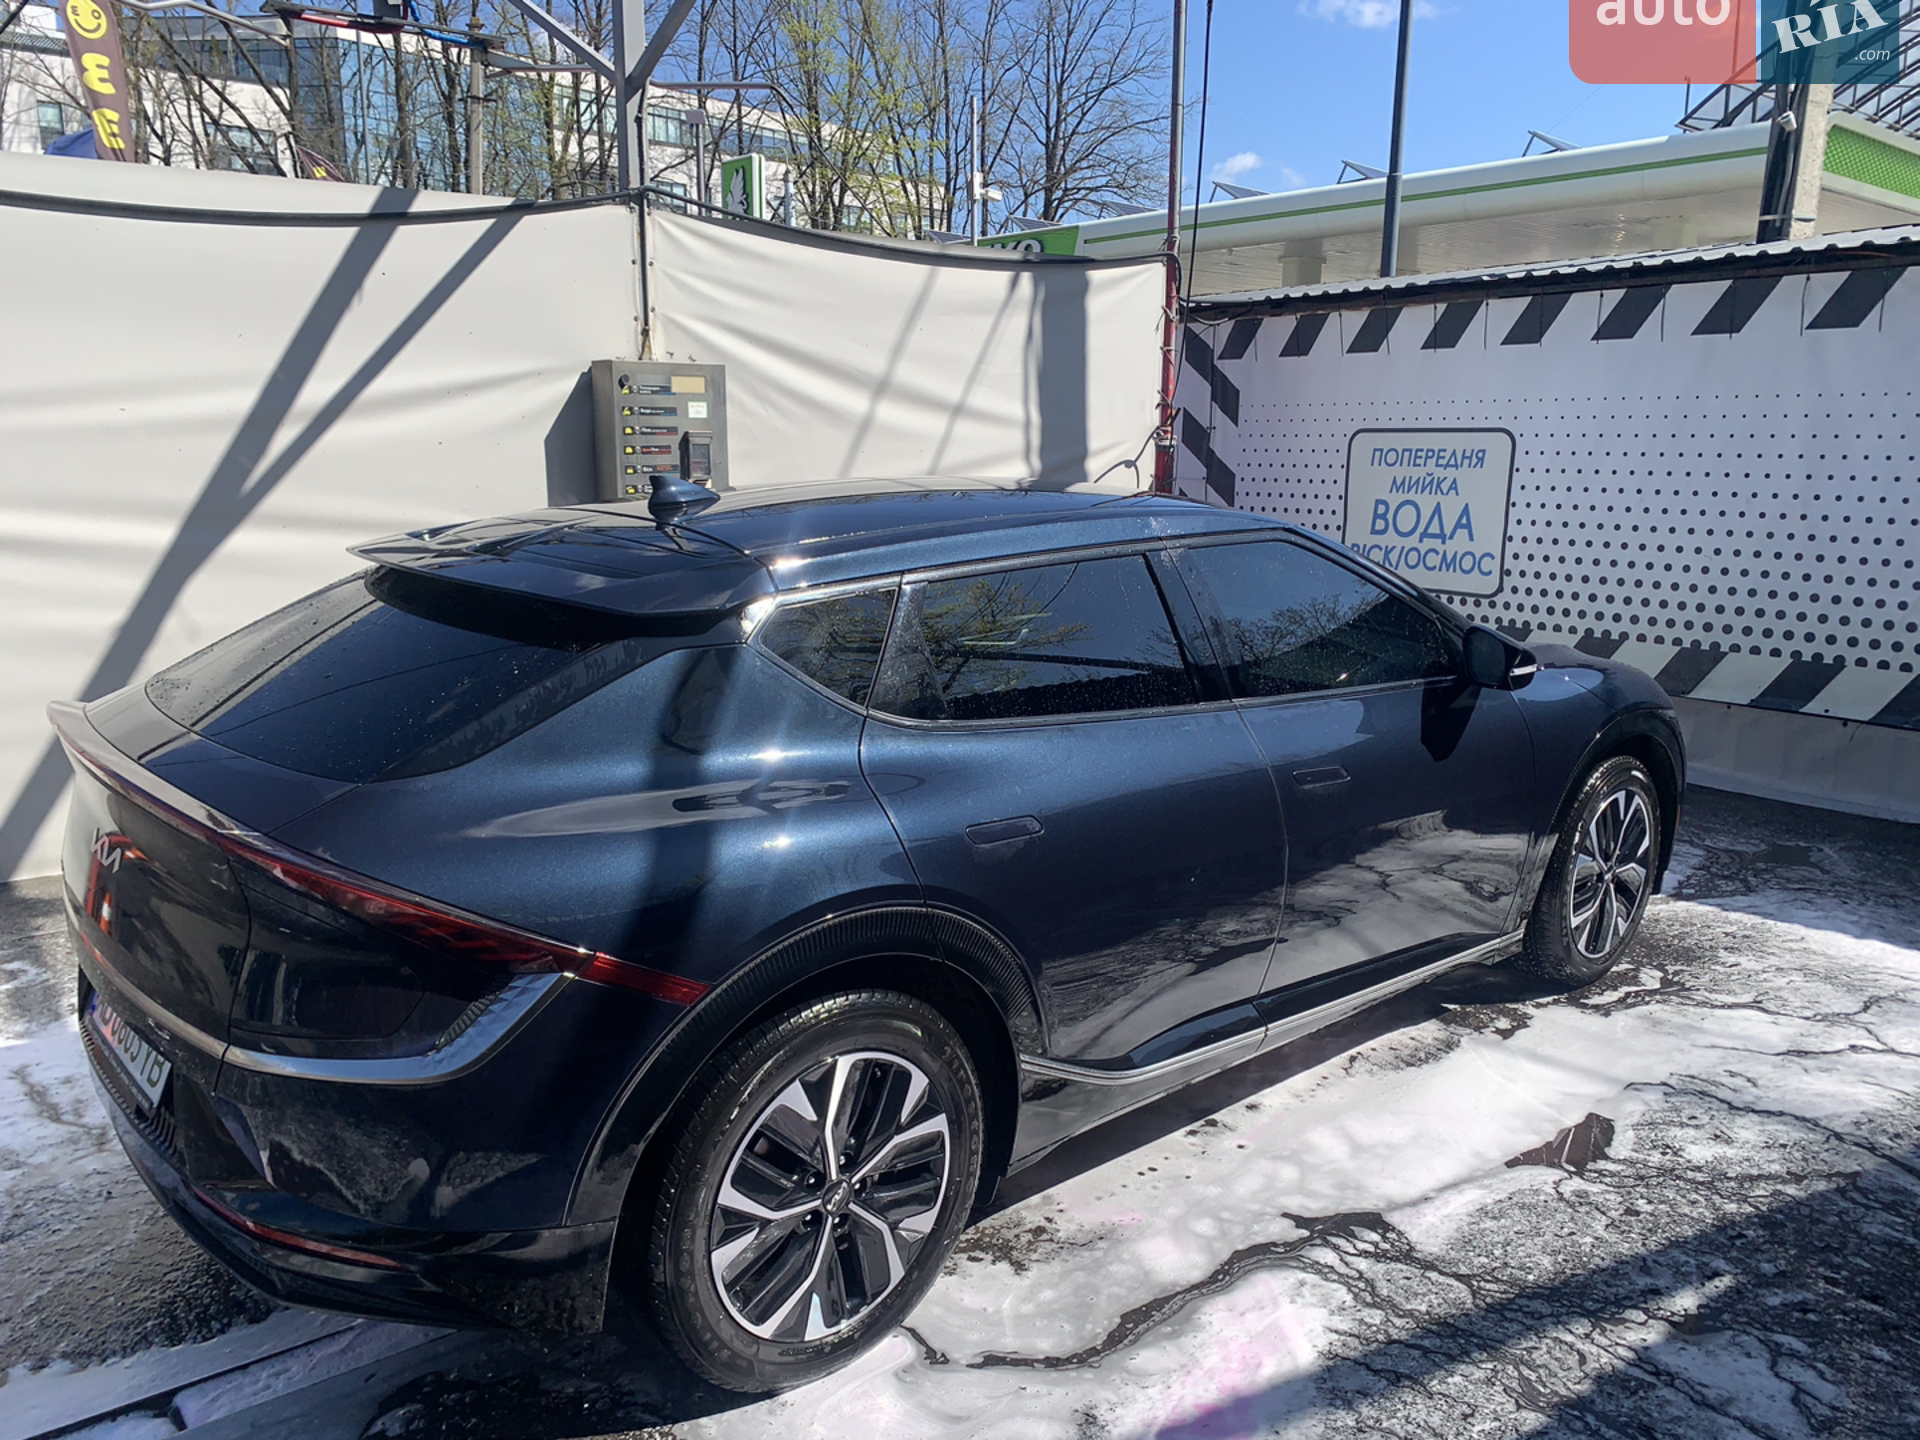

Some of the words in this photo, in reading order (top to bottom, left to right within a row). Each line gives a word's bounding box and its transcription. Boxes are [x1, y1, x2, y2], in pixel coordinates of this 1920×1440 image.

[1370, 448, 1487, 470] ПОПЕРЕДНЯ
[1389, 472, 1460, 496] МИЙКА
[1370, 499, 1475, 545] ВОДА
